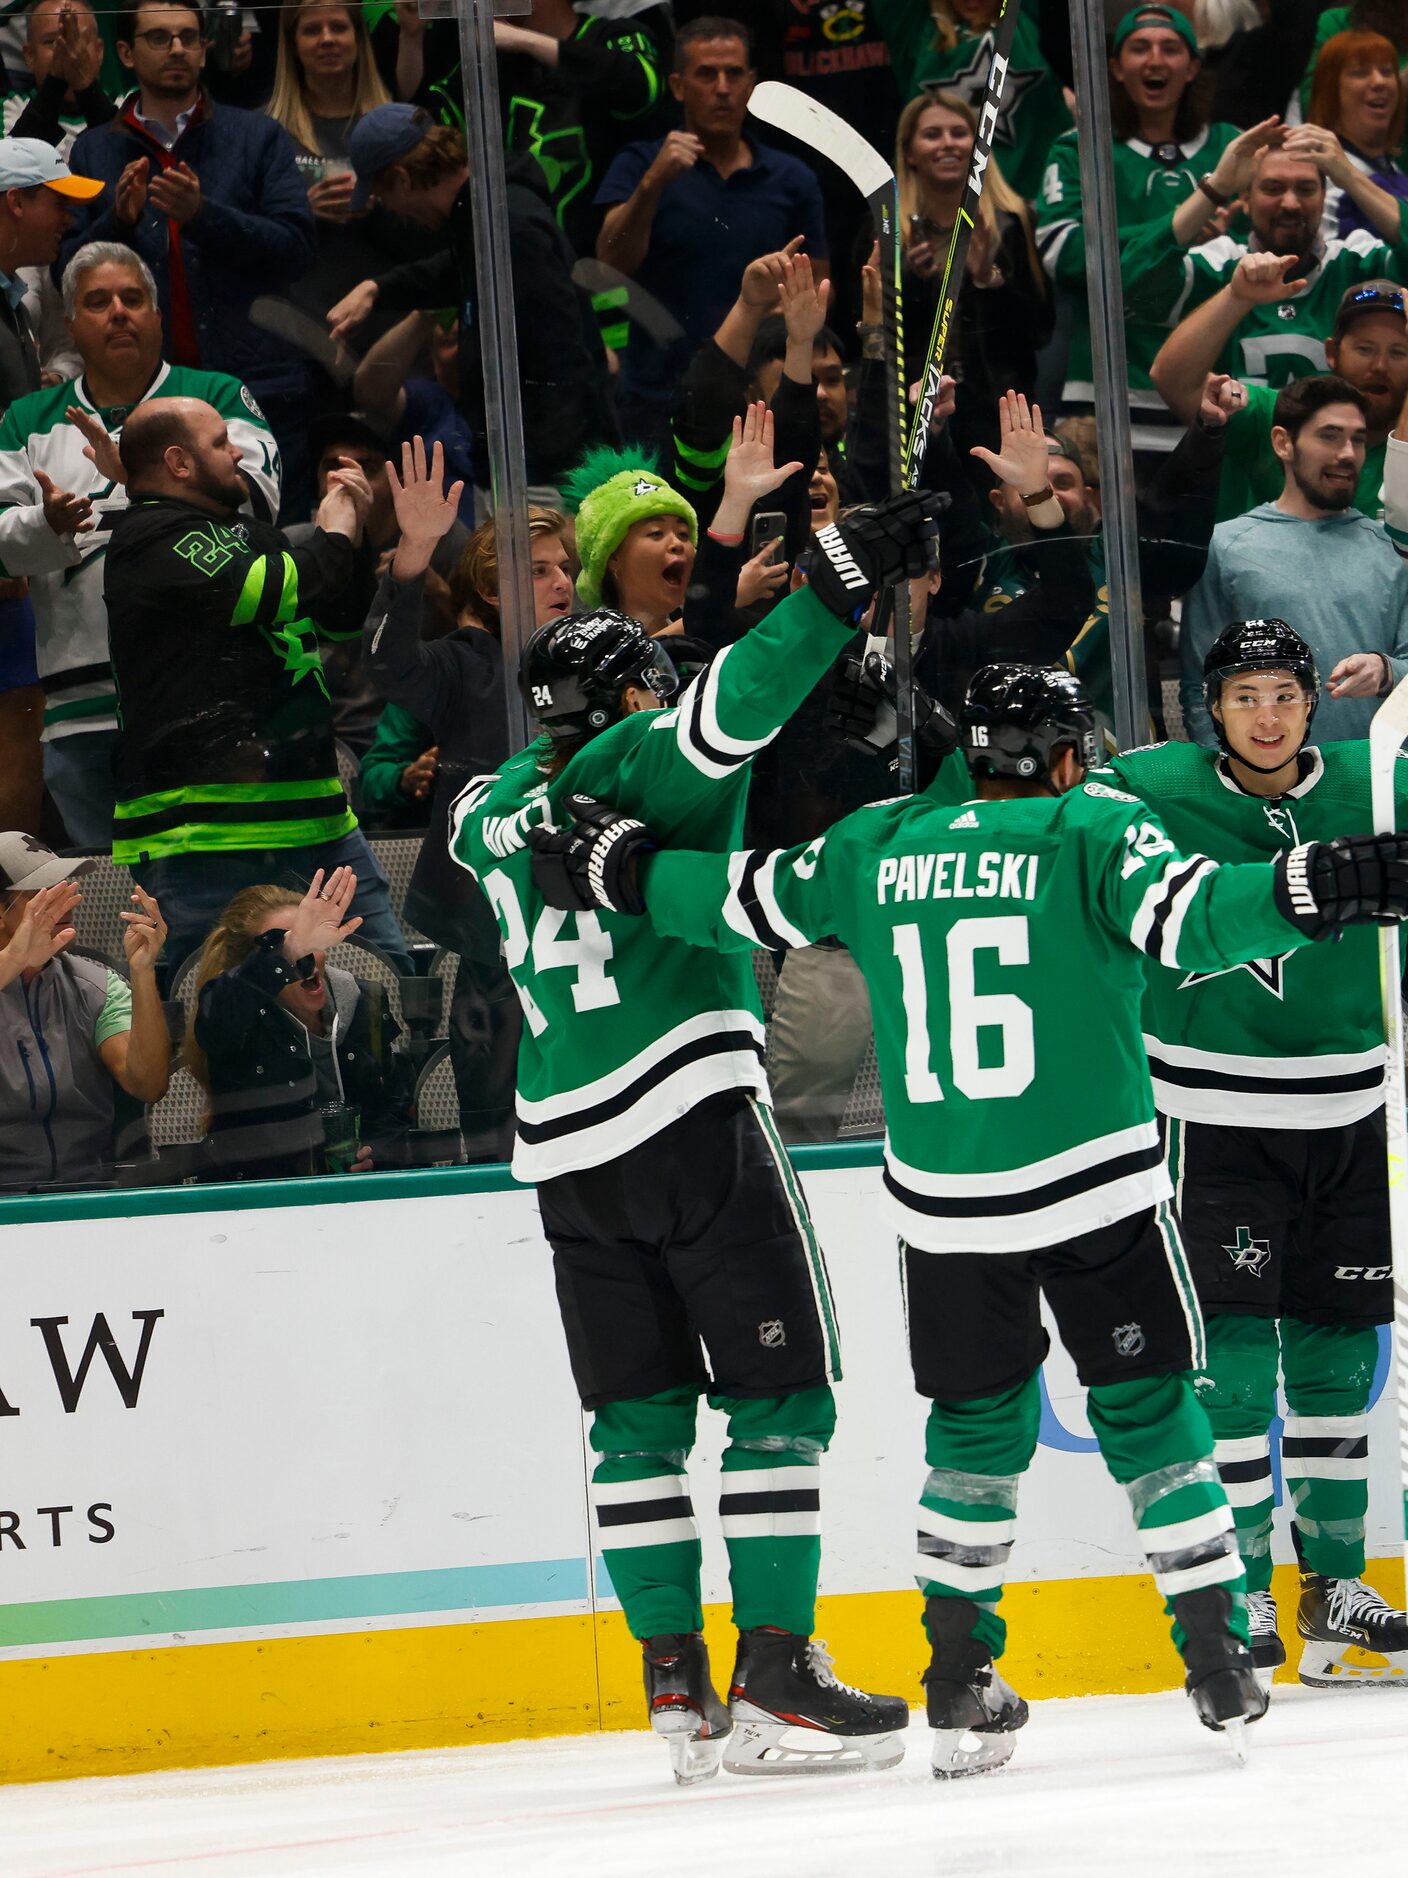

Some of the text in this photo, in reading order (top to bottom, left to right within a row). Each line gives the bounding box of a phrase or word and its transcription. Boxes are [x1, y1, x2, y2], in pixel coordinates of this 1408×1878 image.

[968, 52, 1009, 196] CCM
[935, 297, 953, 362] SUPER
[913, 362, 944, 461] TACKS
[173, 521, 249, 578] 24
[1240, 639, 1277, 649] CCM
[531, 685, 553, 707] 24
[970, 725, 989, 748] 16
[949, 820, 980, 830] adidas
[877, 851, 1039, 905] PAVELSKI
[891, 915, 1036, 1104] 16
[1334, 1265, 1395, 1281] CC
